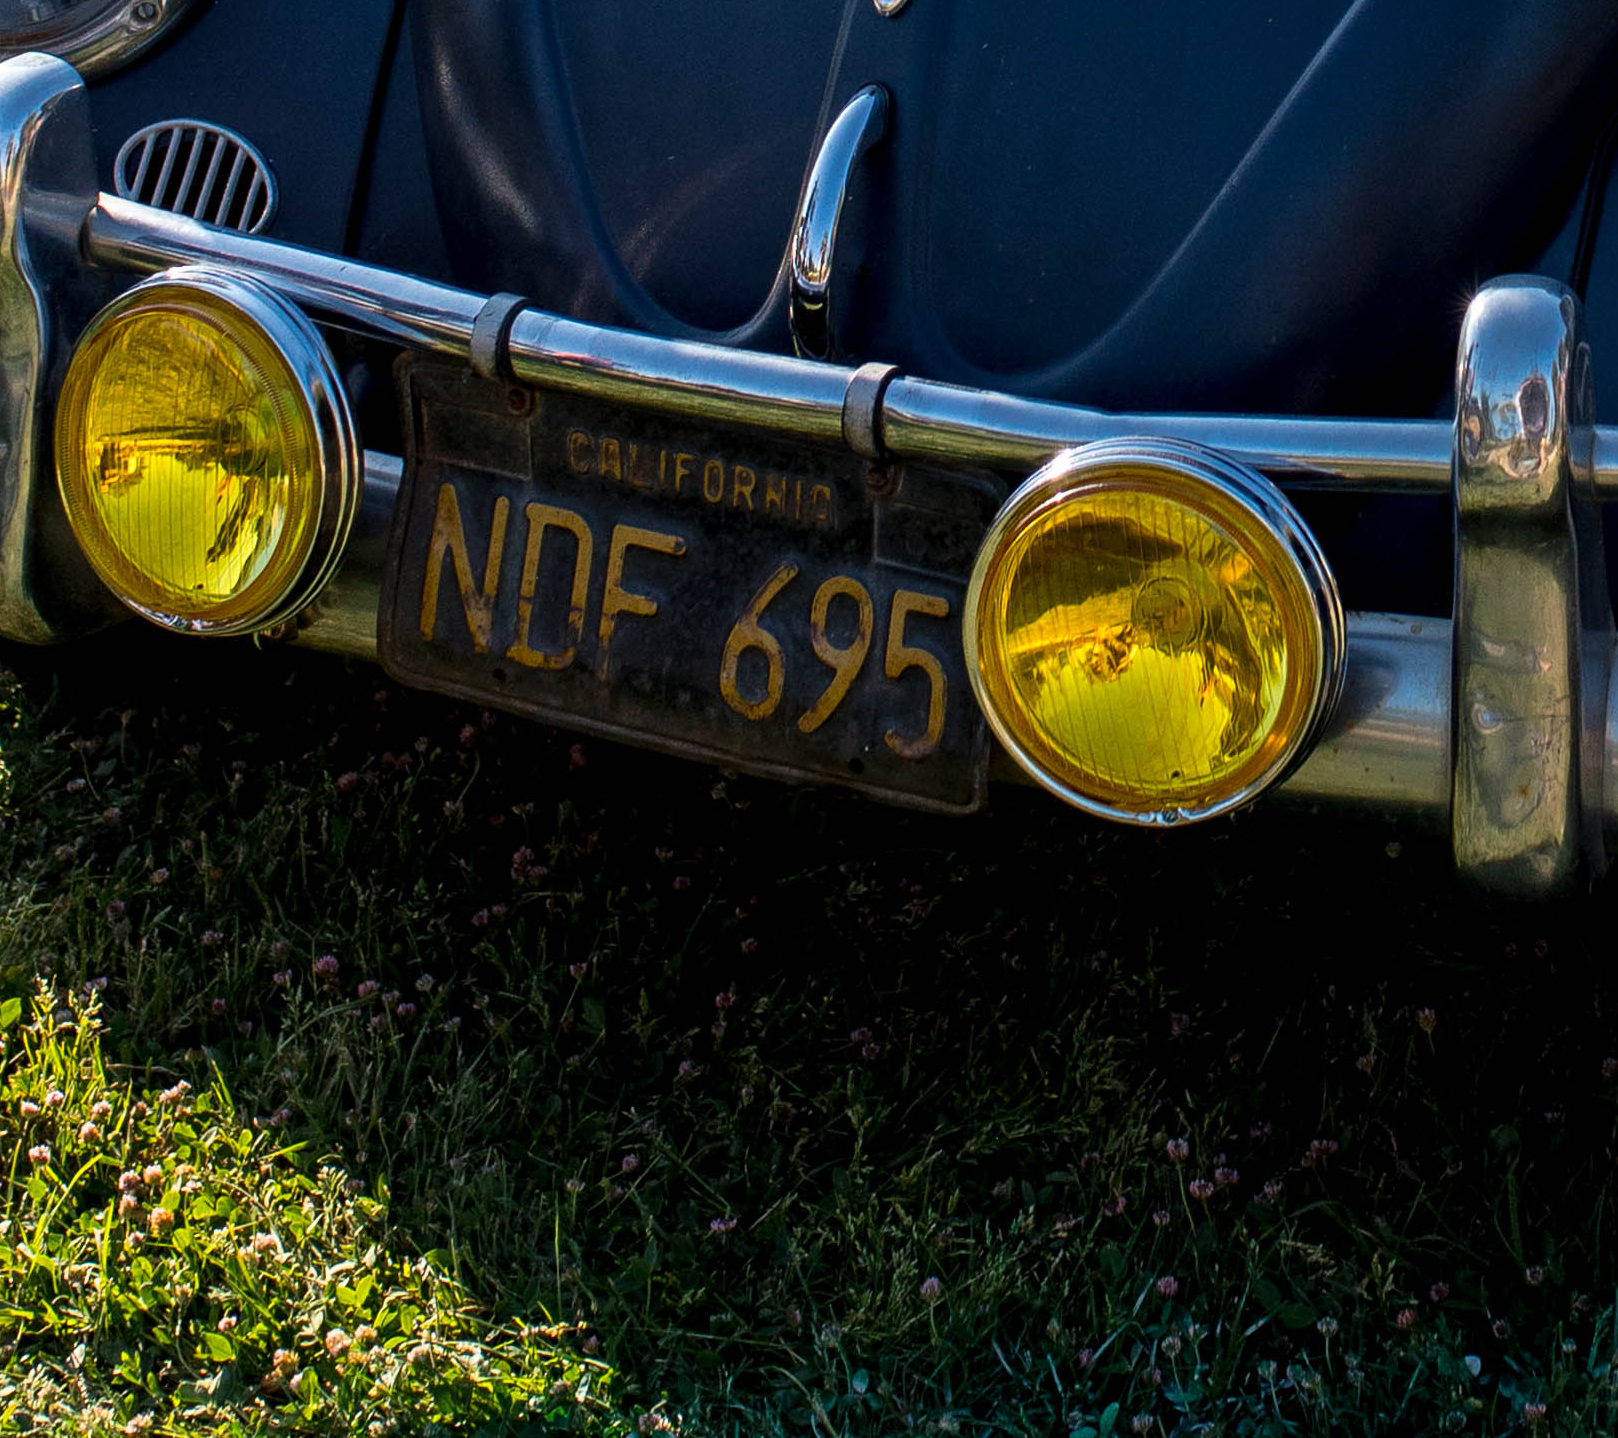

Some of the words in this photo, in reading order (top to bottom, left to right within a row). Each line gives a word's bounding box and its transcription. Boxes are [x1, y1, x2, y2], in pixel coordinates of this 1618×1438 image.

[567, 430, 833, 521] CALIFORNIA
[419, 482, 687, 684] NDF
[719, 563, 949, 760] 695
